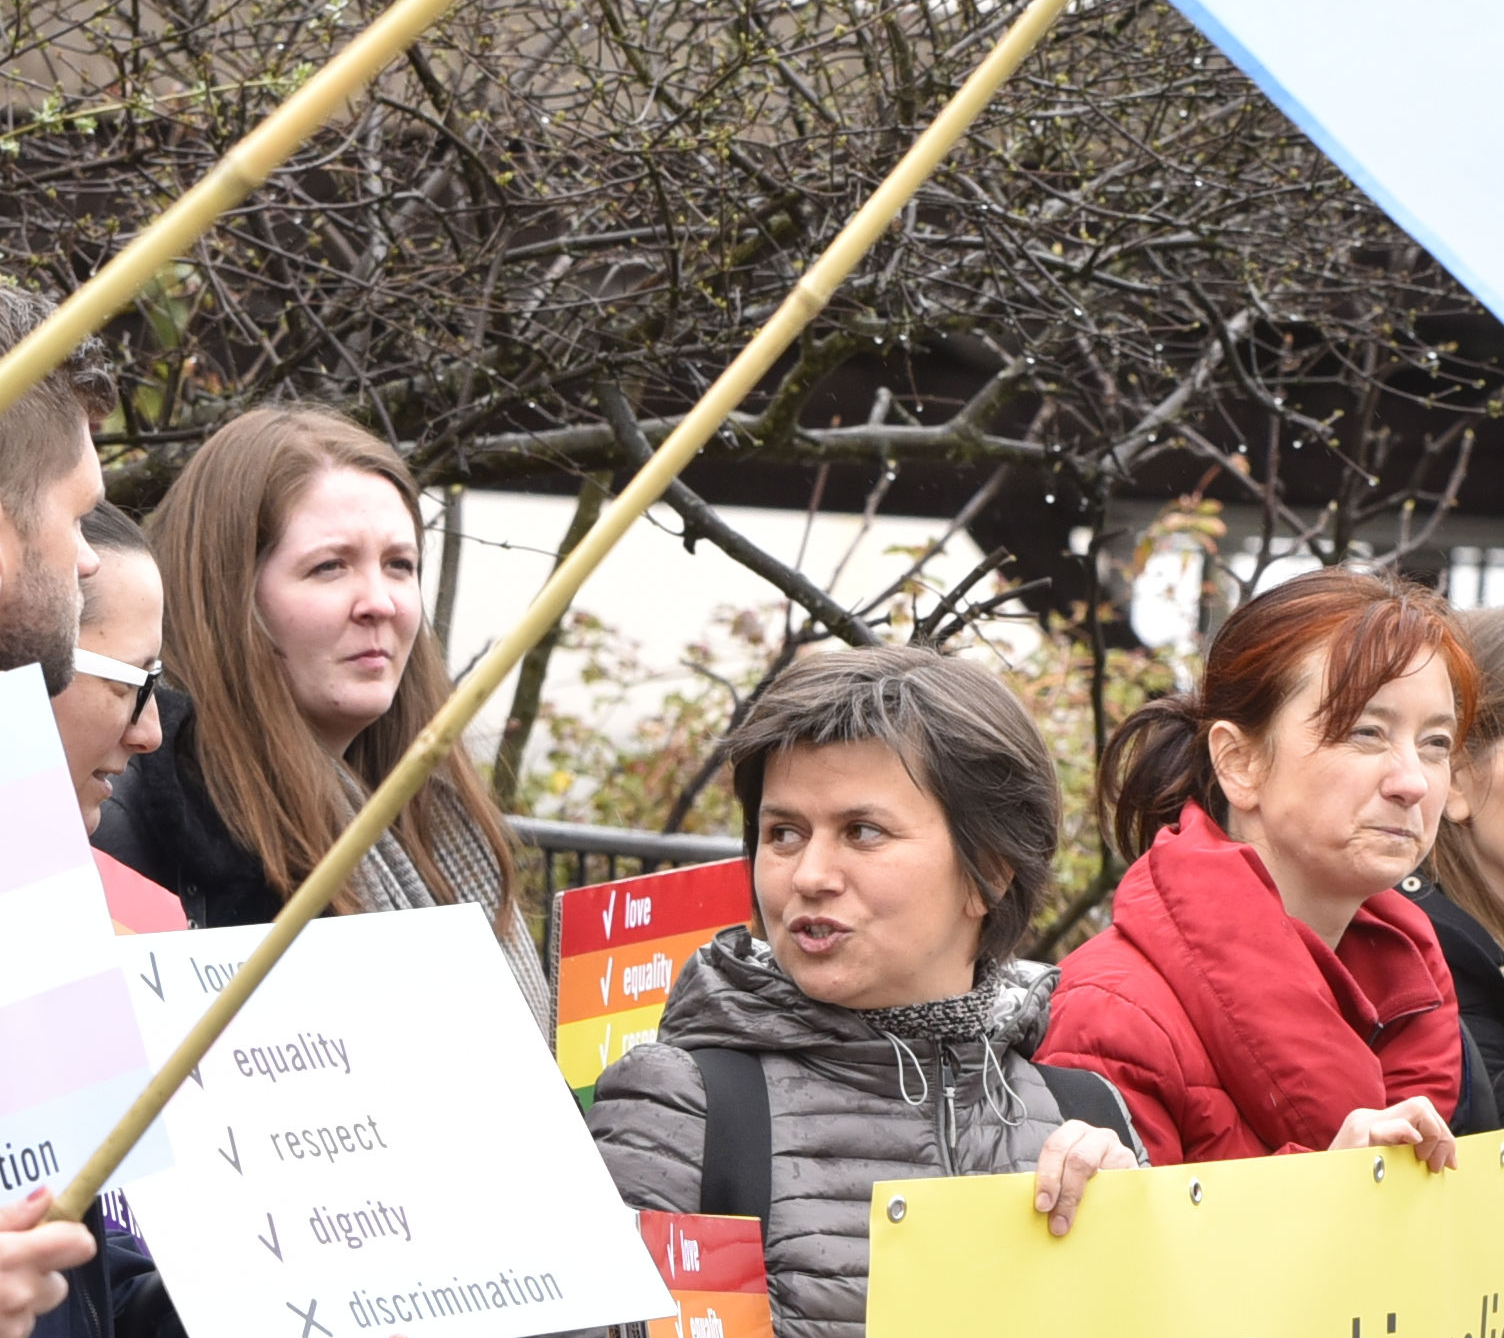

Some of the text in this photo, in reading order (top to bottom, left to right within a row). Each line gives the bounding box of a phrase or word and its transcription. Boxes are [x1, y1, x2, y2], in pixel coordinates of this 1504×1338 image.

[624, 892, 652, 930] love
[622, 952, 673, 1002] equality
[233, 1032, 351, 1083] equality
[269, 1115, 389, 1164] respect
[309, 1200, 412, 1249] dignity
[679, 1229, 701, 1272] love
[347, 1268, 564, 1329] discrimination
